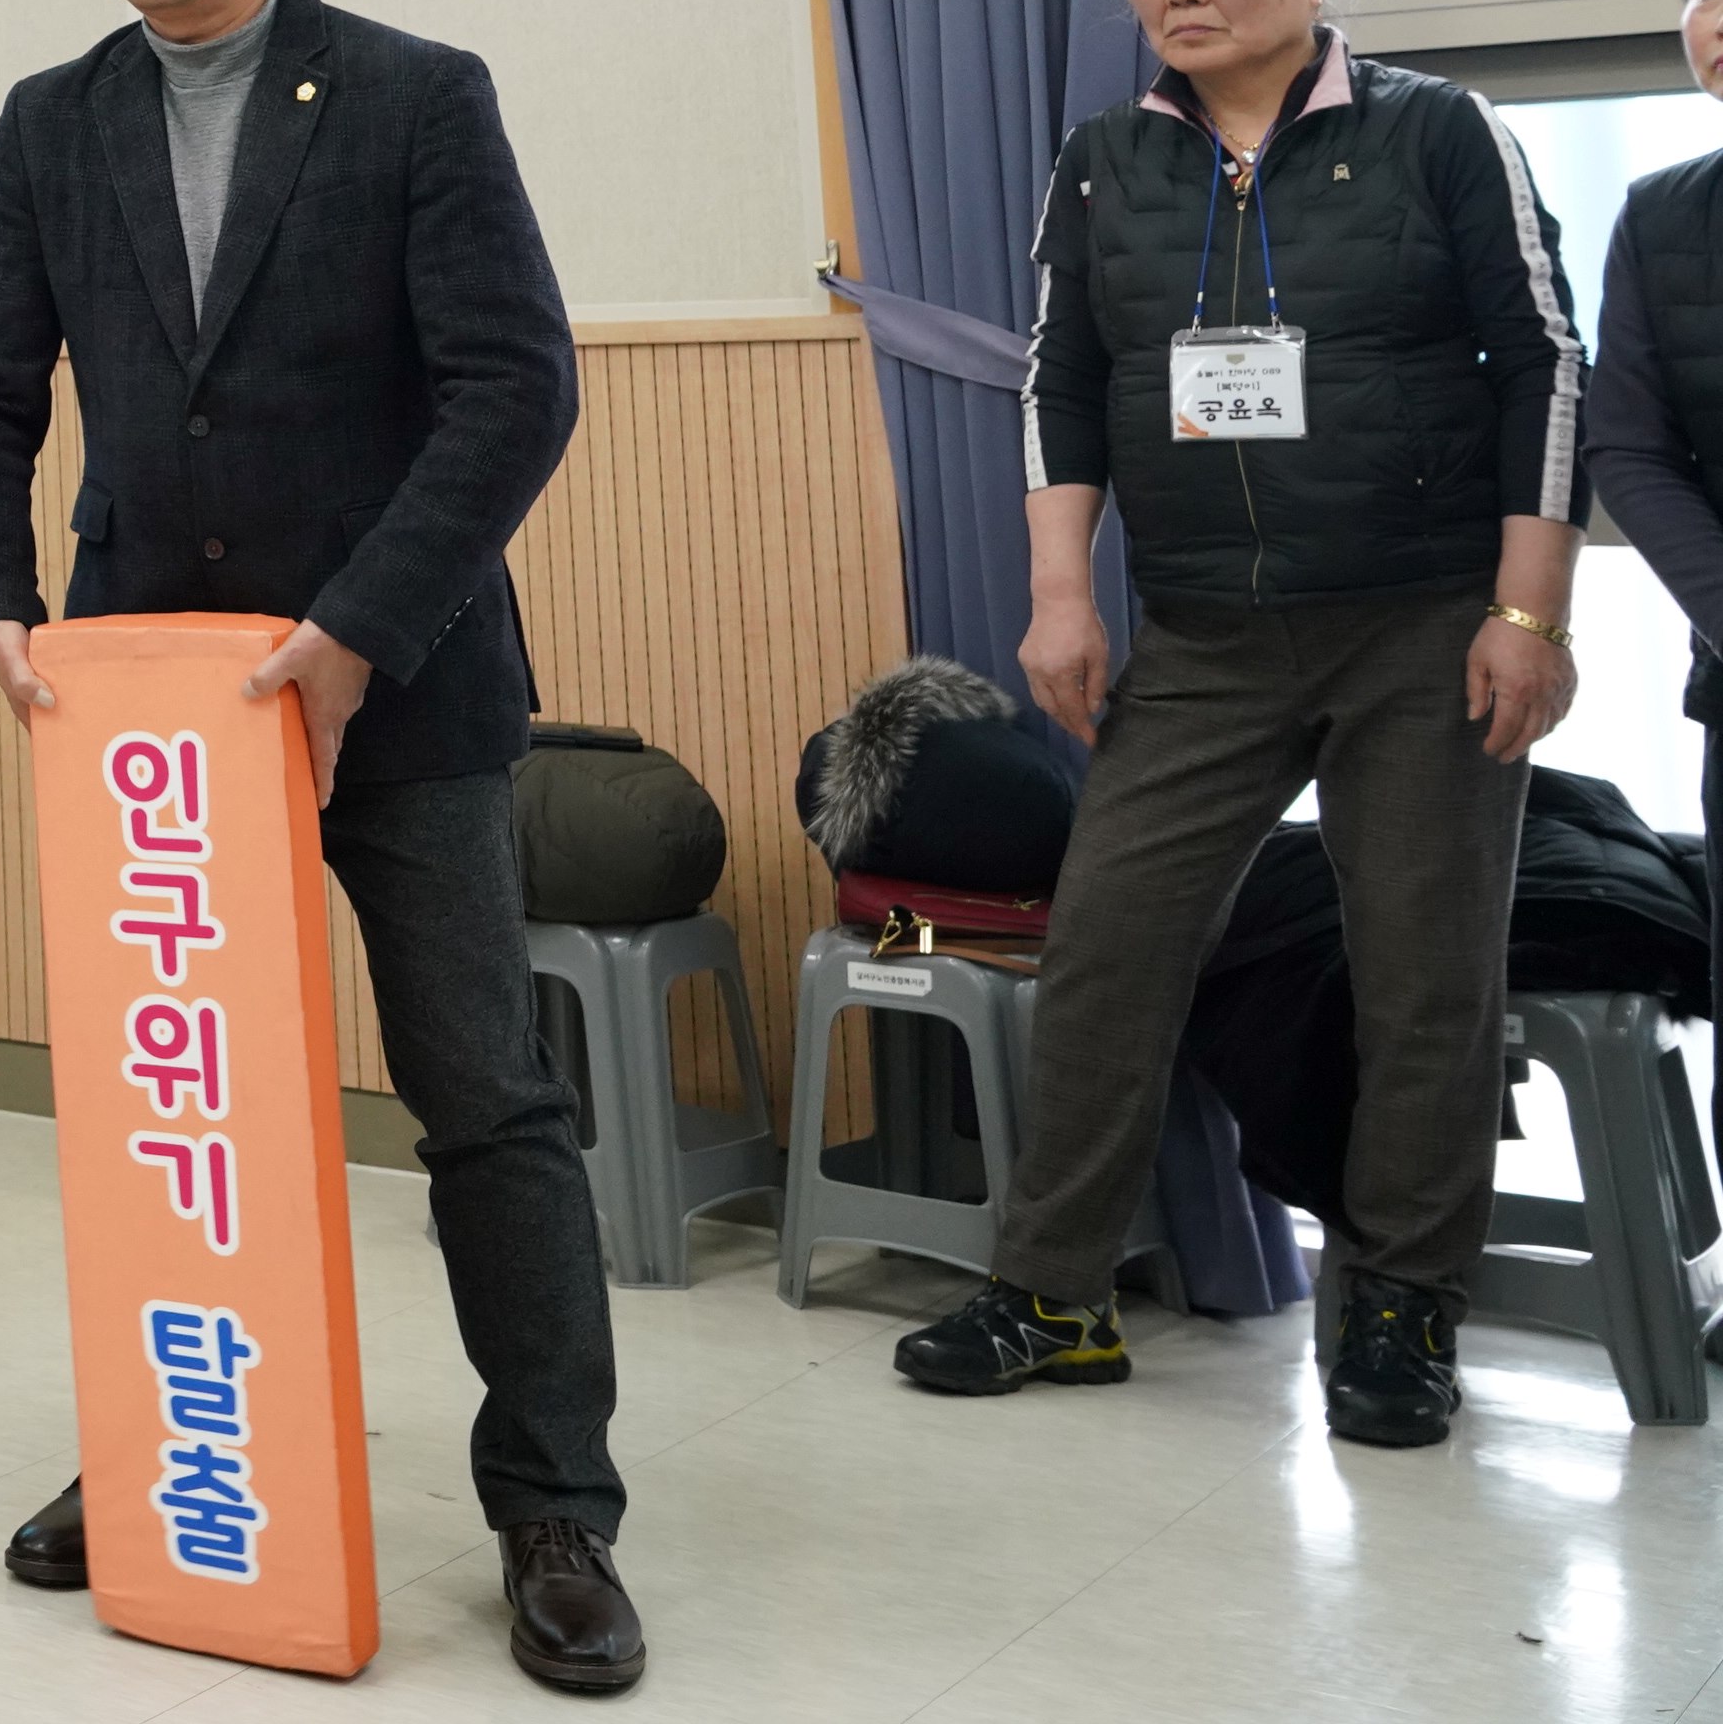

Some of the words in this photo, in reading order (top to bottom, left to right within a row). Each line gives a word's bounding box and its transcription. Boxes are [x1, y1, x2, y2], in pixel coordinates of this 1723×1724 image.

[1198, 397, 1282, 422] 공윤옥
[114, 742, 229, 1245] 인구위기
[153, 1311, 257, 1573] 탈출
